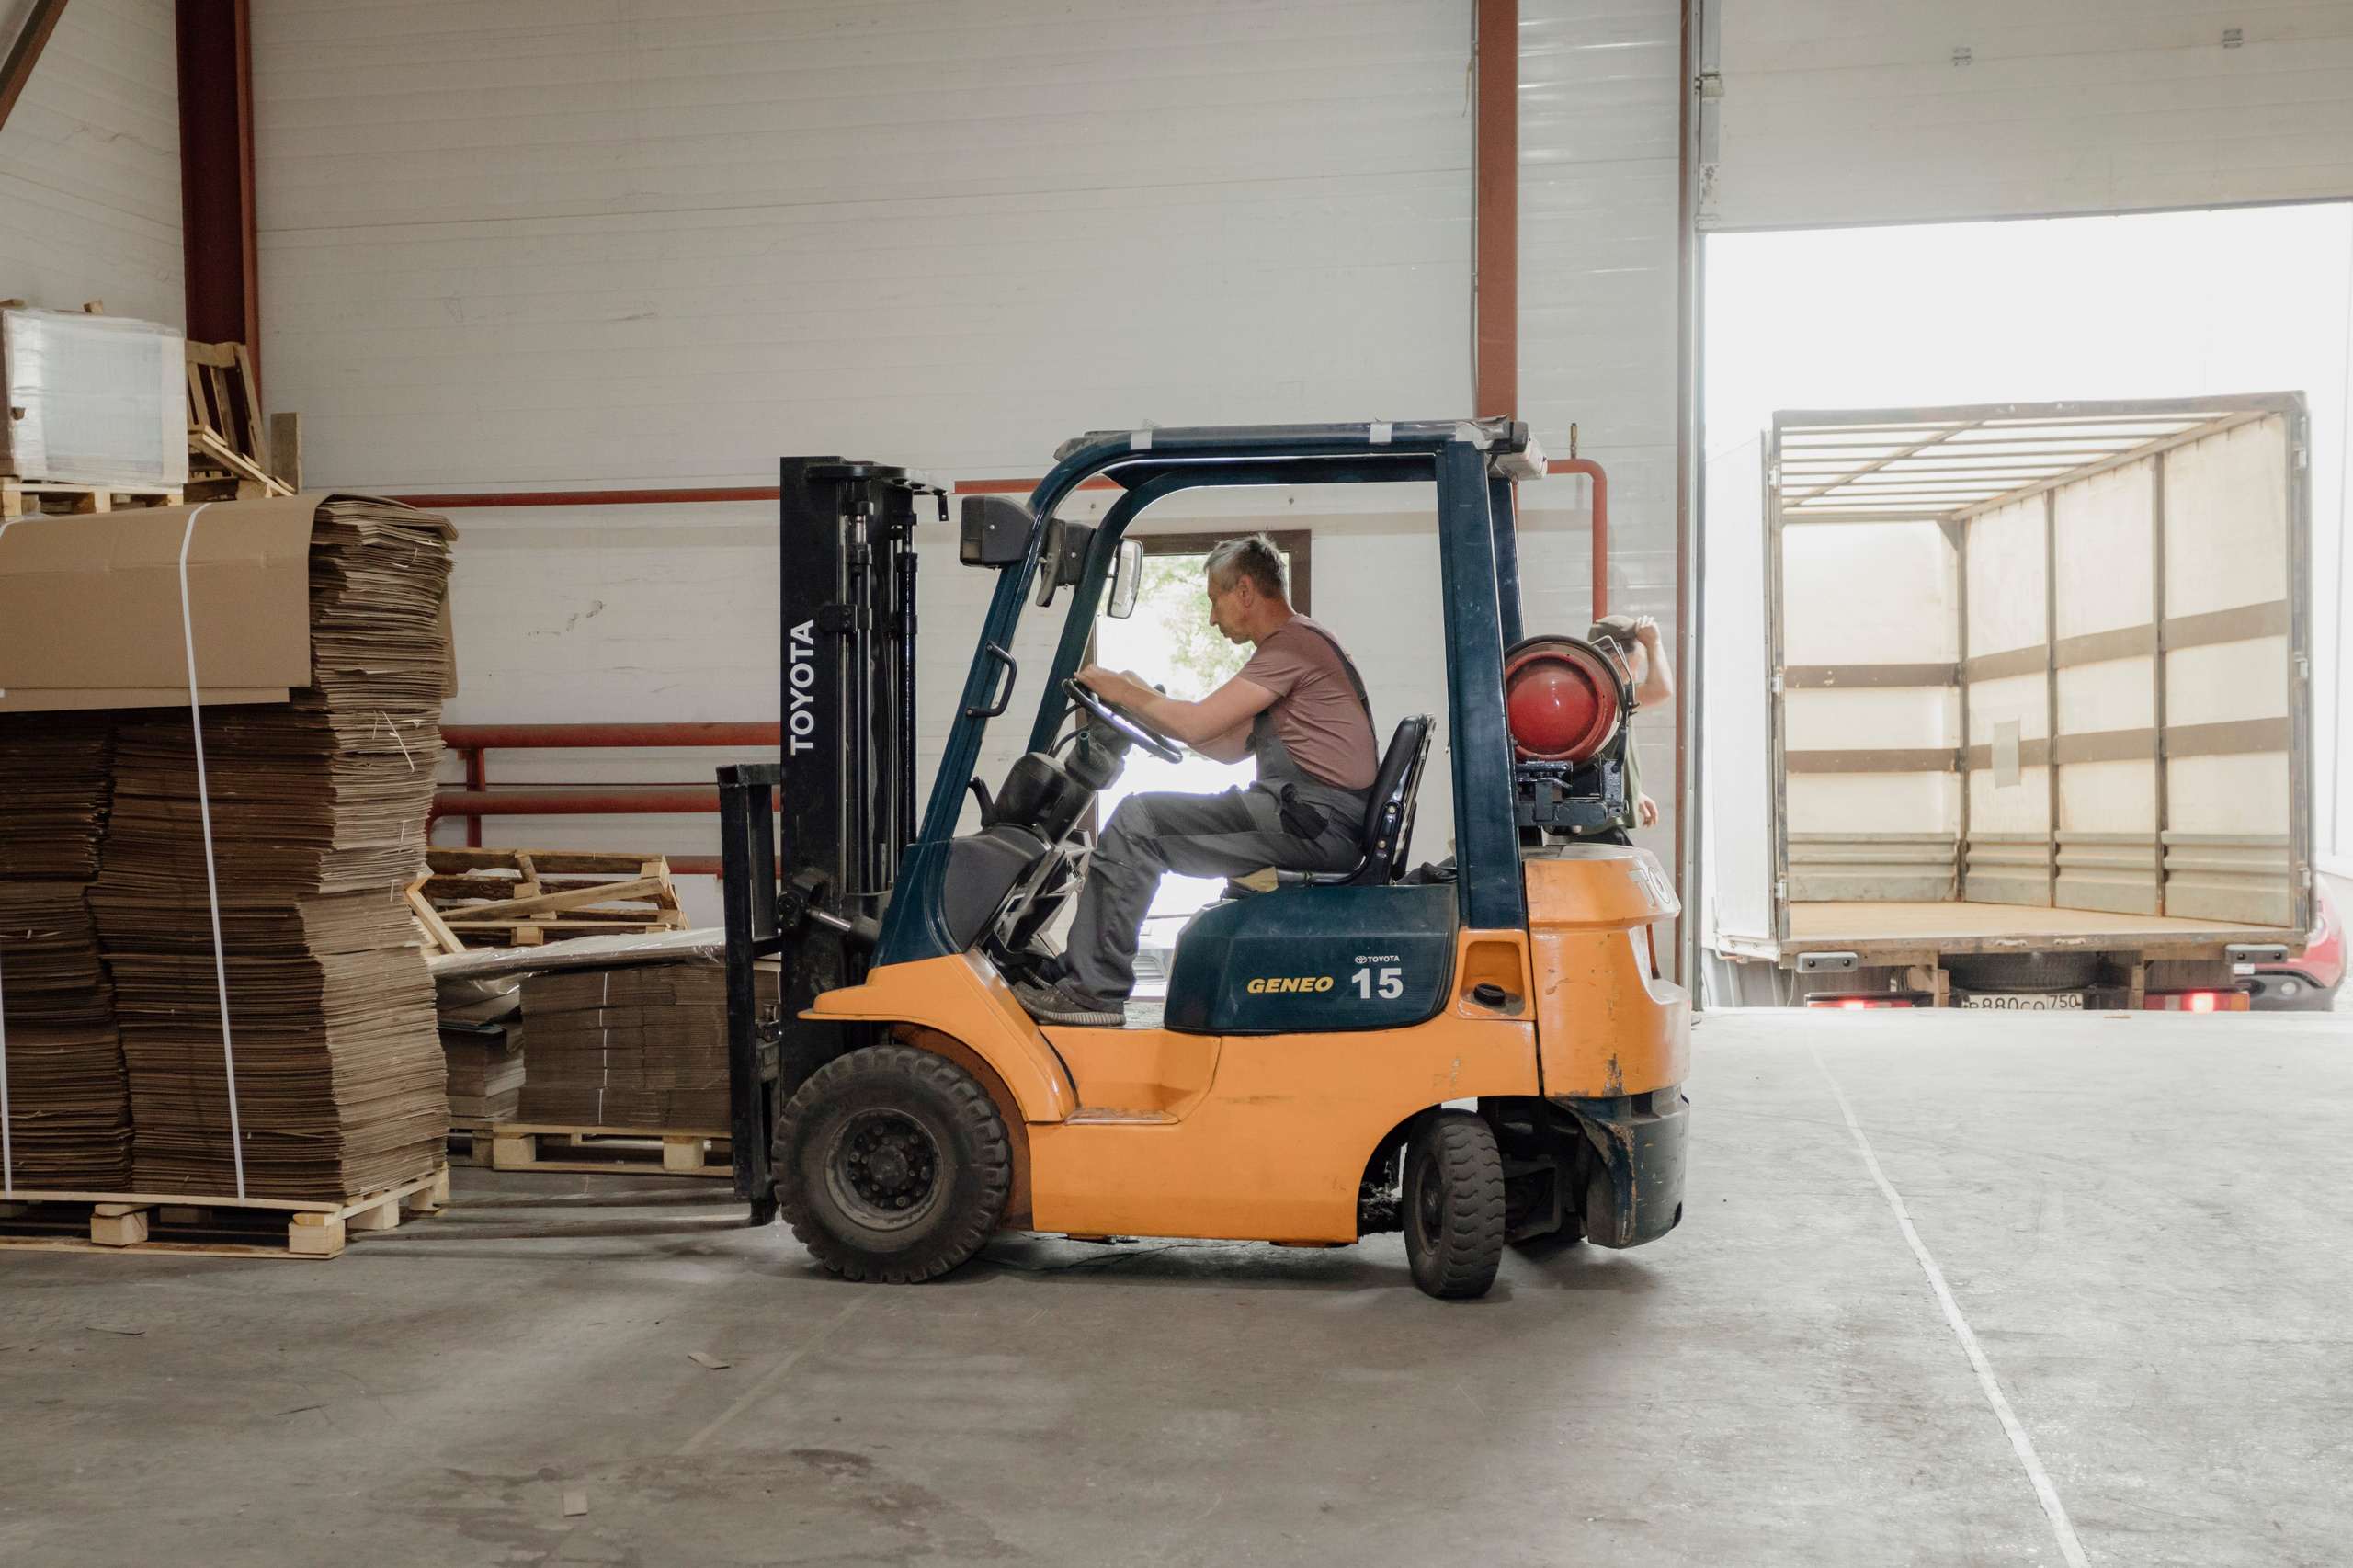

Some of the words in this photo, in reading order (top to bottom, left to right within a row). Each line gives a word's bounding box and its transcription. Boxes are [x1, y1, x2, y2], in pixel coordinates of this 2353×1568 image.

[790, 619, 814, 756] TOYOTA
[1368, 955, 1400, 963] TOYOTA
[1247, 976, 1334, 994] GENEO
[1351, 967, 1404, 999] 15
[2049, 994, 2077, 1009] 750
